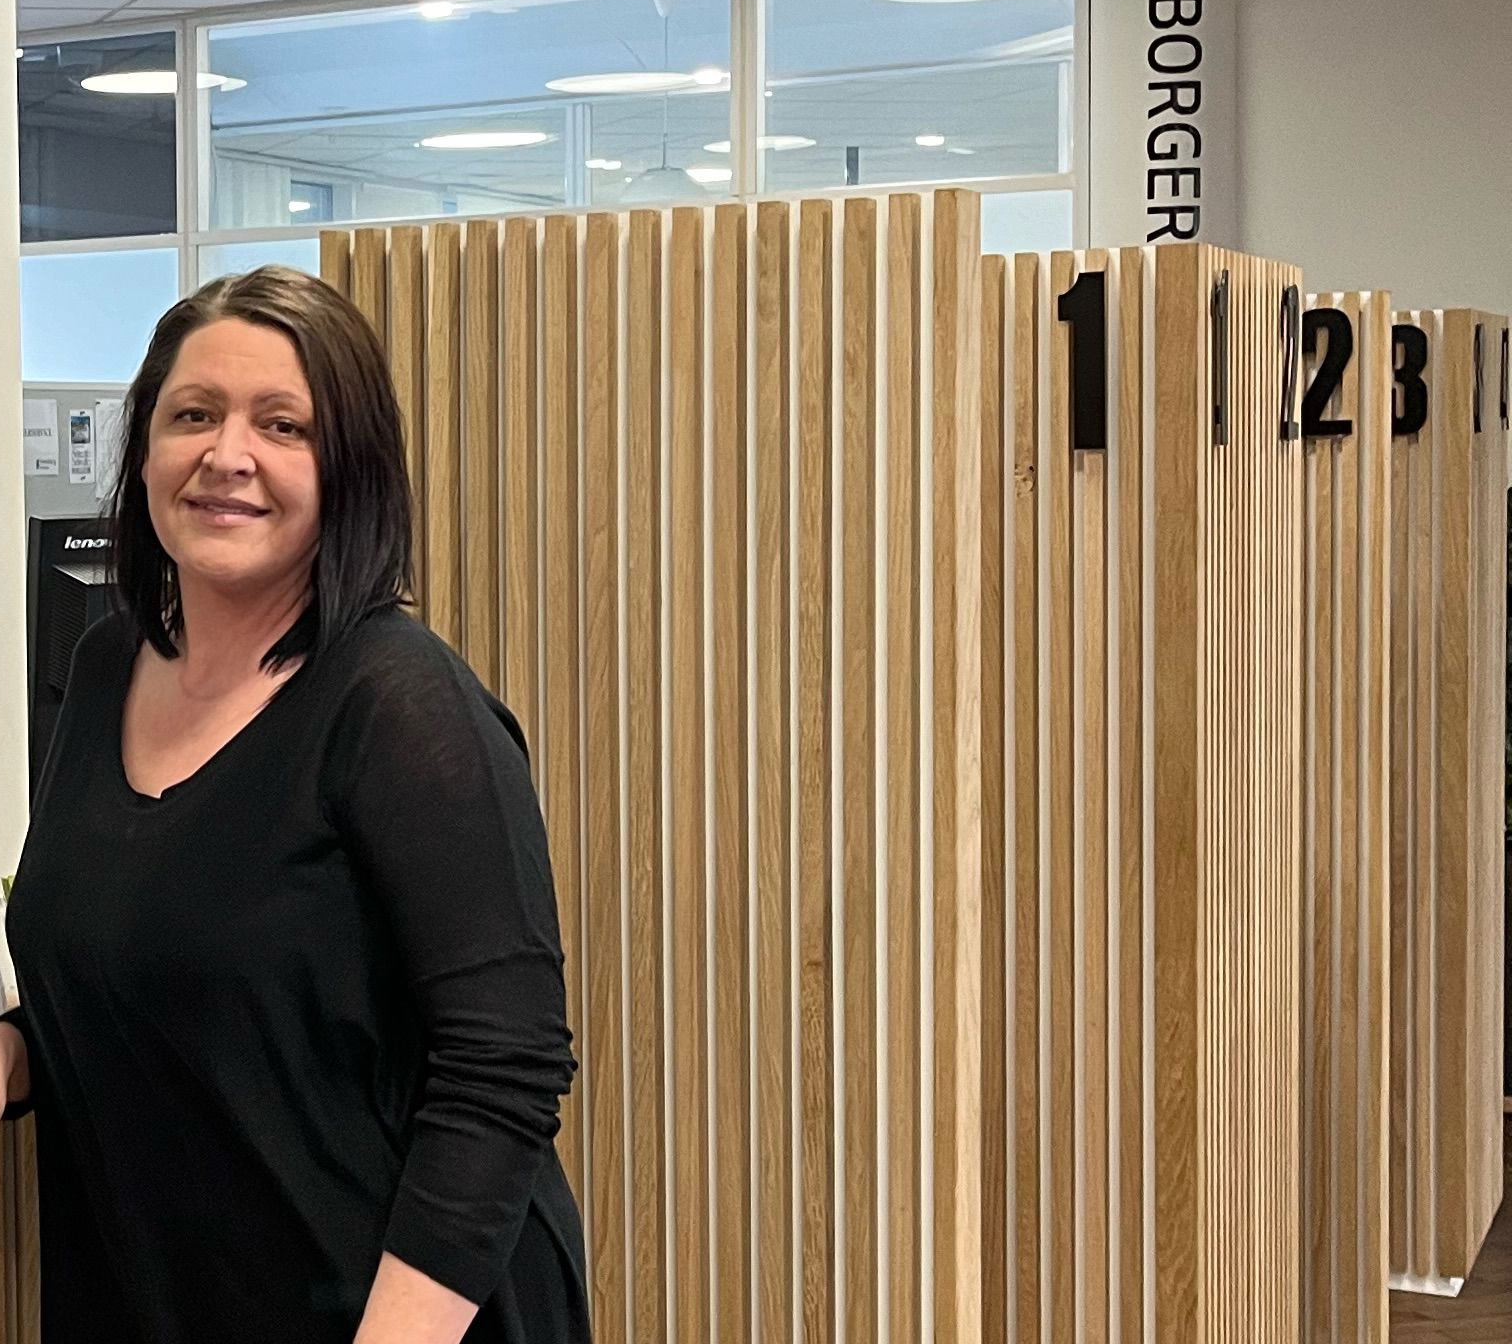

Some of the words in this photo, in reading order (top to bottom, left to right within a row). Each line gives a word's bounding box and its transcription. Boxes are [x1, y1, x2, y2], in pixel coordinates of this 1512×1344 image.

[1057, 271, 1107, 450] 1
[1300, 307, 1354, 436] 2
[64, 536, 117, 550] leno
